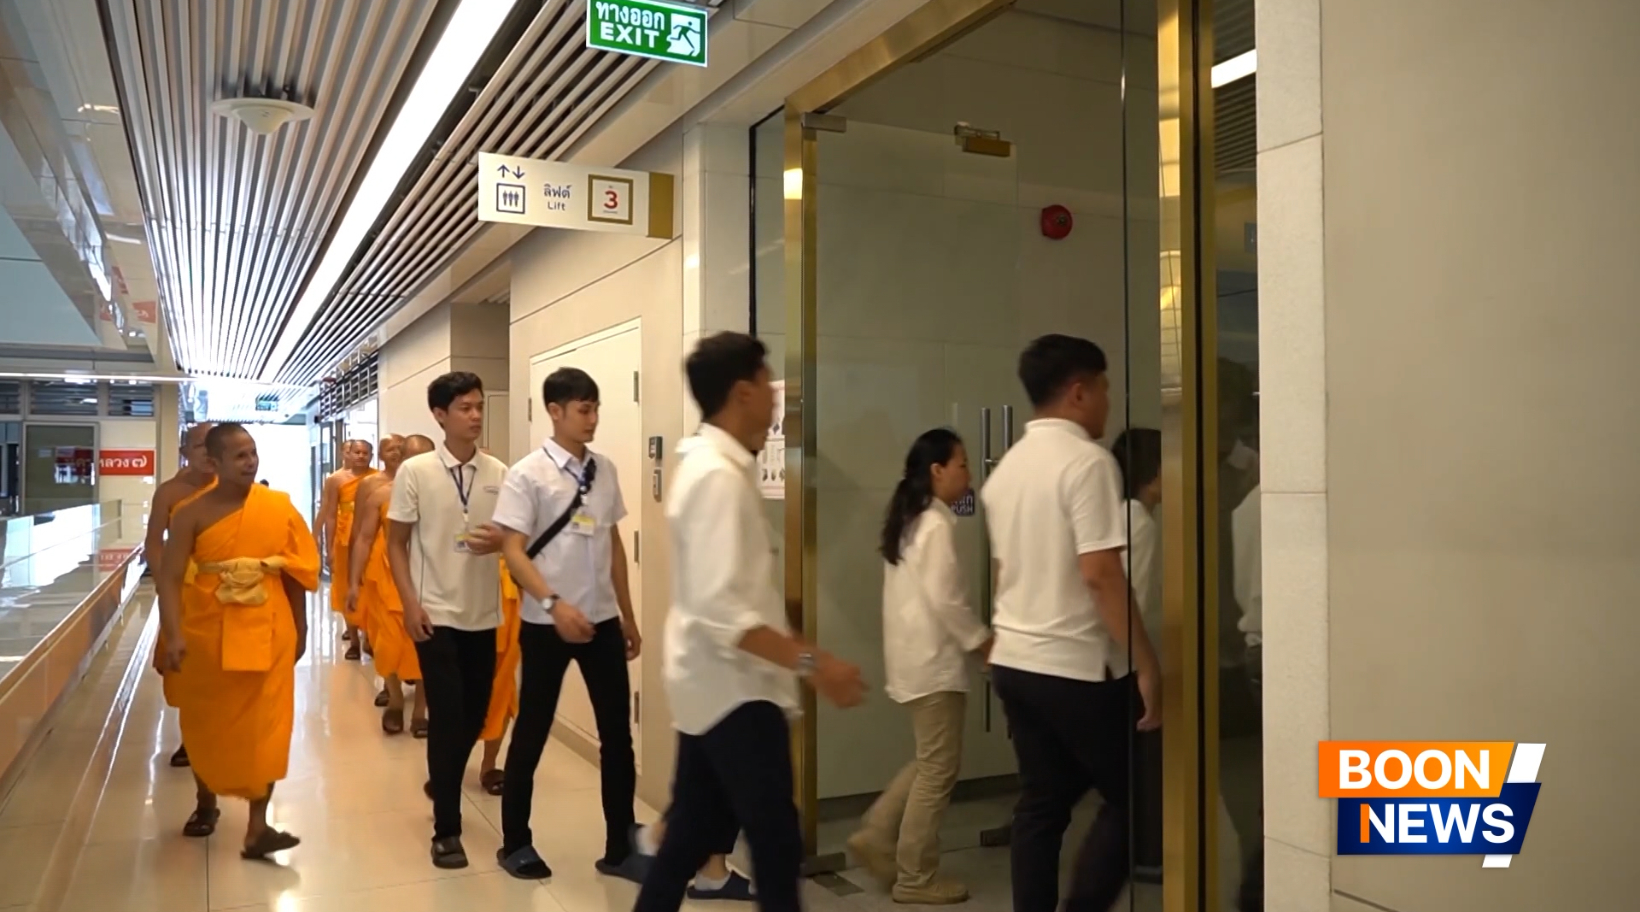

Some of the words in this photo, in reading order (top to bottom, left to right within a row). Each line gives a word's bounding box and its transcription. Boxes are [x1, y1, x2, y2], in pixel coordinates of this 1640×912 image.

[596, 1, 665, 31] ทางออก
[600, 21, 660, 48] EXIT
[543, 183, 572, 199] ลิฟต์
[603, 190, 618, 210] 3
[547, 201, 566, 211] Lift
